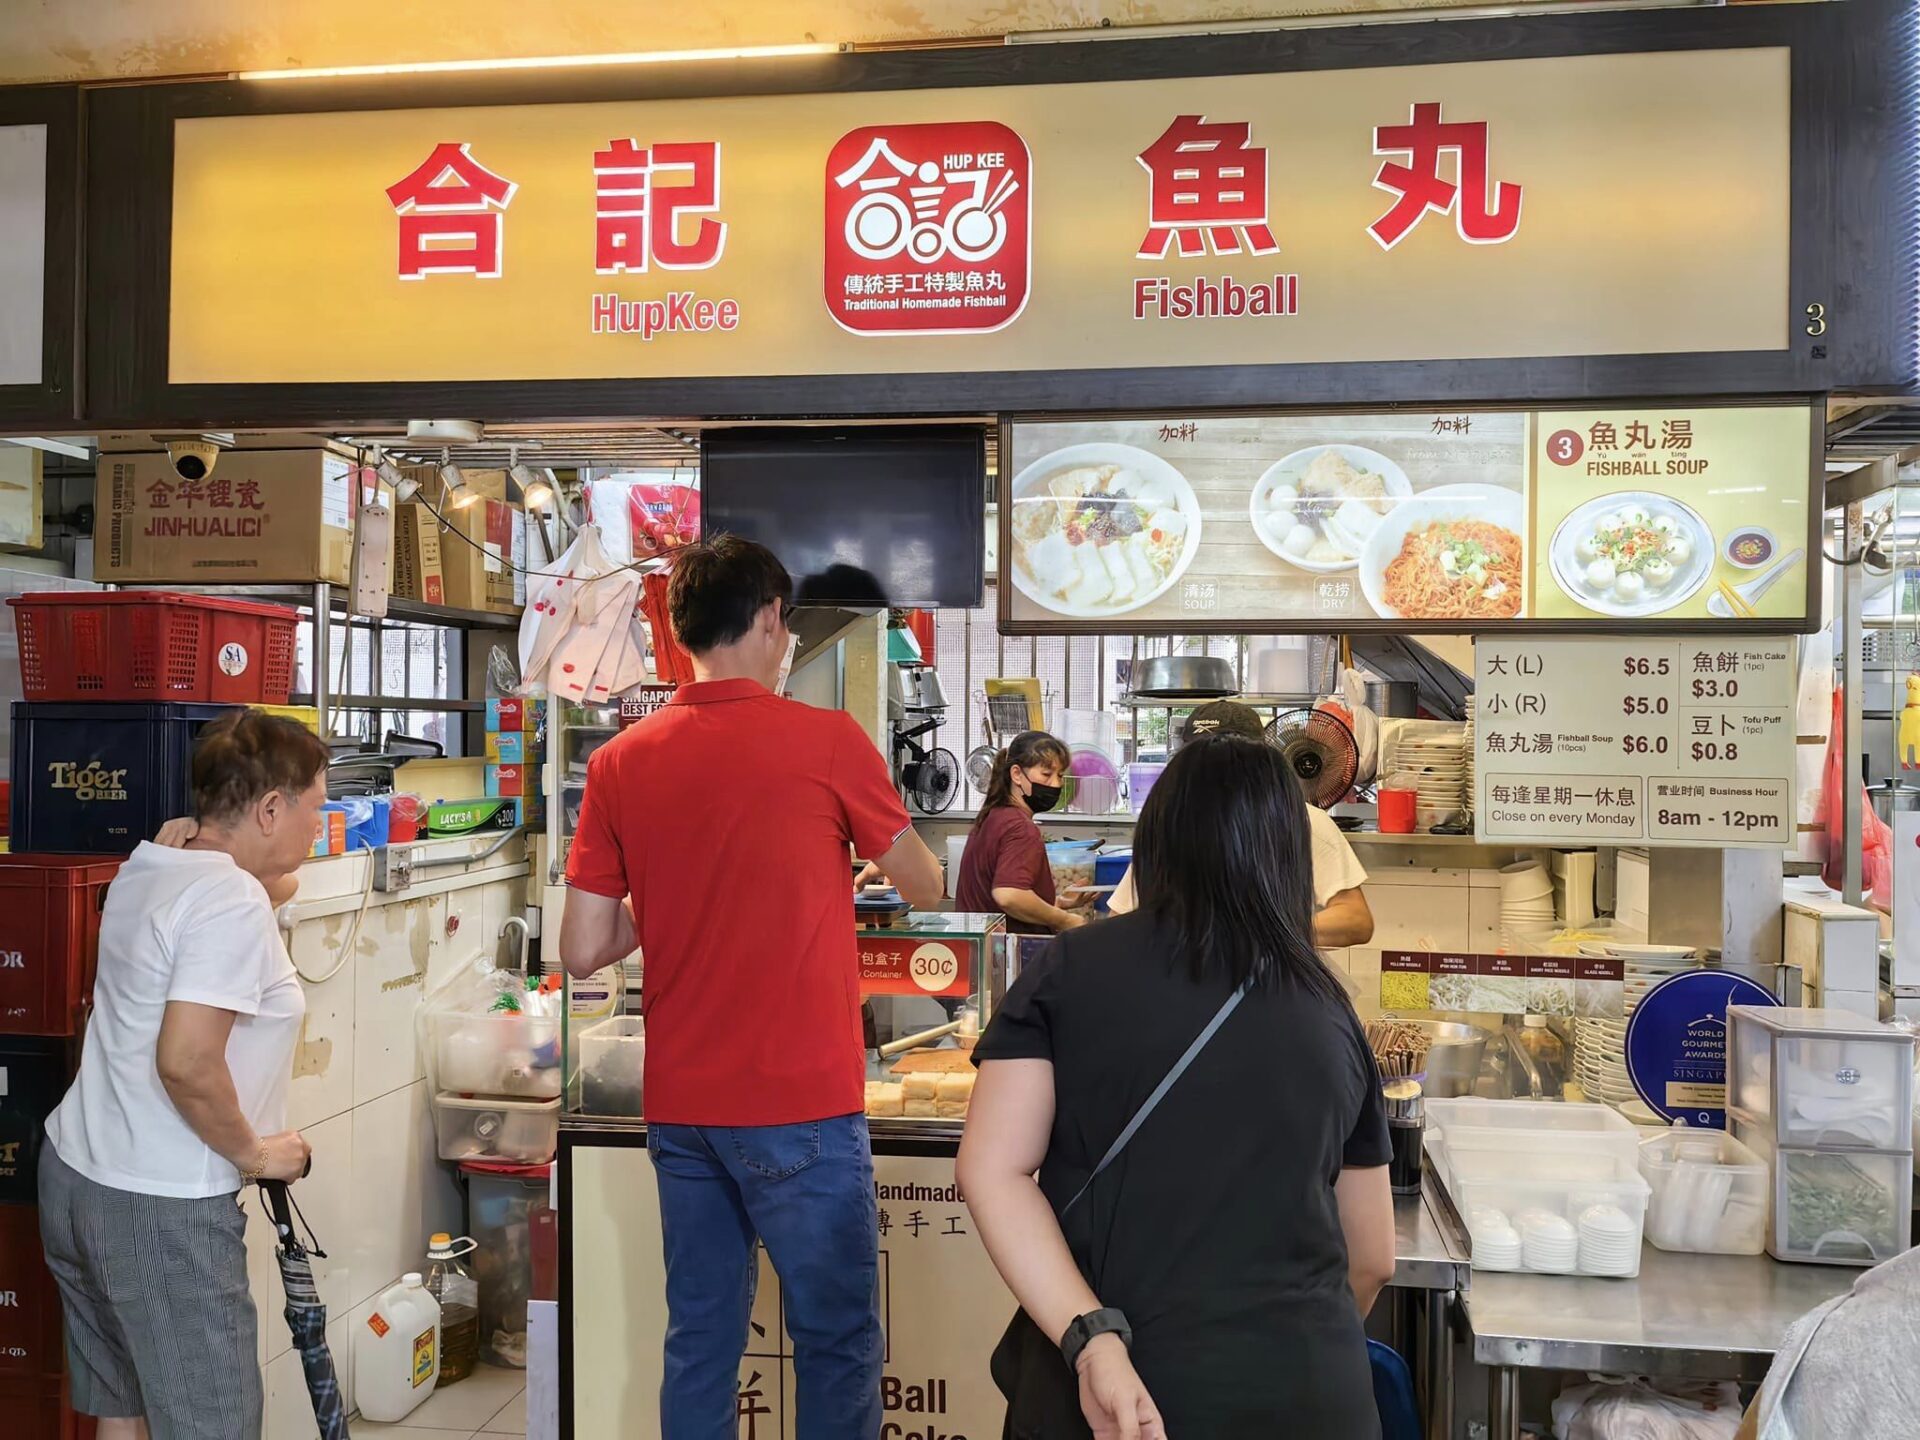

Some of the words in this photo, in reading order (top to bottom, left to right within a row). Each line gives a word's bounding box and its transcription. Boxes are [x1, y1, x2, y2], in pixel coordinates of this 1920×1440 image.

[943, 154, 973, 170] HUP
[977, 152, 1005, 168] KEE
[844, 270, 1006, 295] 傳統手工特製魚丸
[844, 297, 899, 311] Traditional
[902, 297, 961, 310] Homemade
[964, 295, 1006, 307] Fishball
[1133, 273, 1298, 320] Fishball
[592, 291, 740, 340] HupKee
[1806, 302, 1826, 336] 3
[1159, 422, 1199, 443] 加料
[1431, 415, 1472, 435] 加料
[1588, 420, 1693, 451] 魚丸湯
[1557, 436, 1573, 460] 3
[1587, 461, 1661, 476] FISHBALL
[1666, 459, 1709, 475] SOUP
[144, 516, 261, 537] JINHUALICI
[1184, 583, 1215, 598] 清汤
[1184, 599, 1215, 610] SOUP
[1322, 599, 1345, 609] DRY
[1487, 655, 1508, 675] 大
[1516, 654, 1543, 677] (L)
[1624, 656, 1670, 677] $6.5
[1693, 651, 1739, 673] 魚餅
[1743, 652, 1763, 660] Fish
[1764, 652, 1786, 660] Cake
[1743, 662, 1765, 671] (1pc)
[1692, 678, 1738, 699] $3.0
[623, 704, 649, 715] BEST
[1487, 693, 1508, 714] 小
[1515, 692, 1546, 715] (R)
[1623, 695, 1669, 716] $5.0
[1691, 714, 1735, 736] 豆卜
[1742, 716, 1762, 724] Tofu
[1763, 716, 1782, 724] Puff
[1742, 726, 1764, 734] (1pc)
[1486, 731, 1553, 754] 魚丸湯
[1557, 734, 1590, 743] Fishball
[1591, 735, 1614, 744] Soup
[1557, 743, 1587, 752] (10pcs)
[1622, 734, 1668, 755] $6.0
[1691, 741, 1738, 762] $0.8
[48, 761, 128, 800] Tiger
[1657, 784, 1705, 797] 营业时间
[96, 789, 127, 800] BEER
[1491, 784, 1636, 807] 每逢星期一休息
[1709, 787, 1753, 796] Business
[1755, 787, 1778, 796] Hour
[1491, 810, 1527, 822] Close
[1530, 813, 1545, 822] on
[1549, 813, 1583, 826] every
[1586, 812, 1636, 827] Monday
[1658, 809, 1701, 826] 8am
[1722, 810, 1779, 831] 12pm
[863, 969, 903, 979] Container
[914, 958, 953, 976] 30¢
[1688, 1029, 1724, 1037] WORLD
[881, 1376, 946, 1414] Ball
